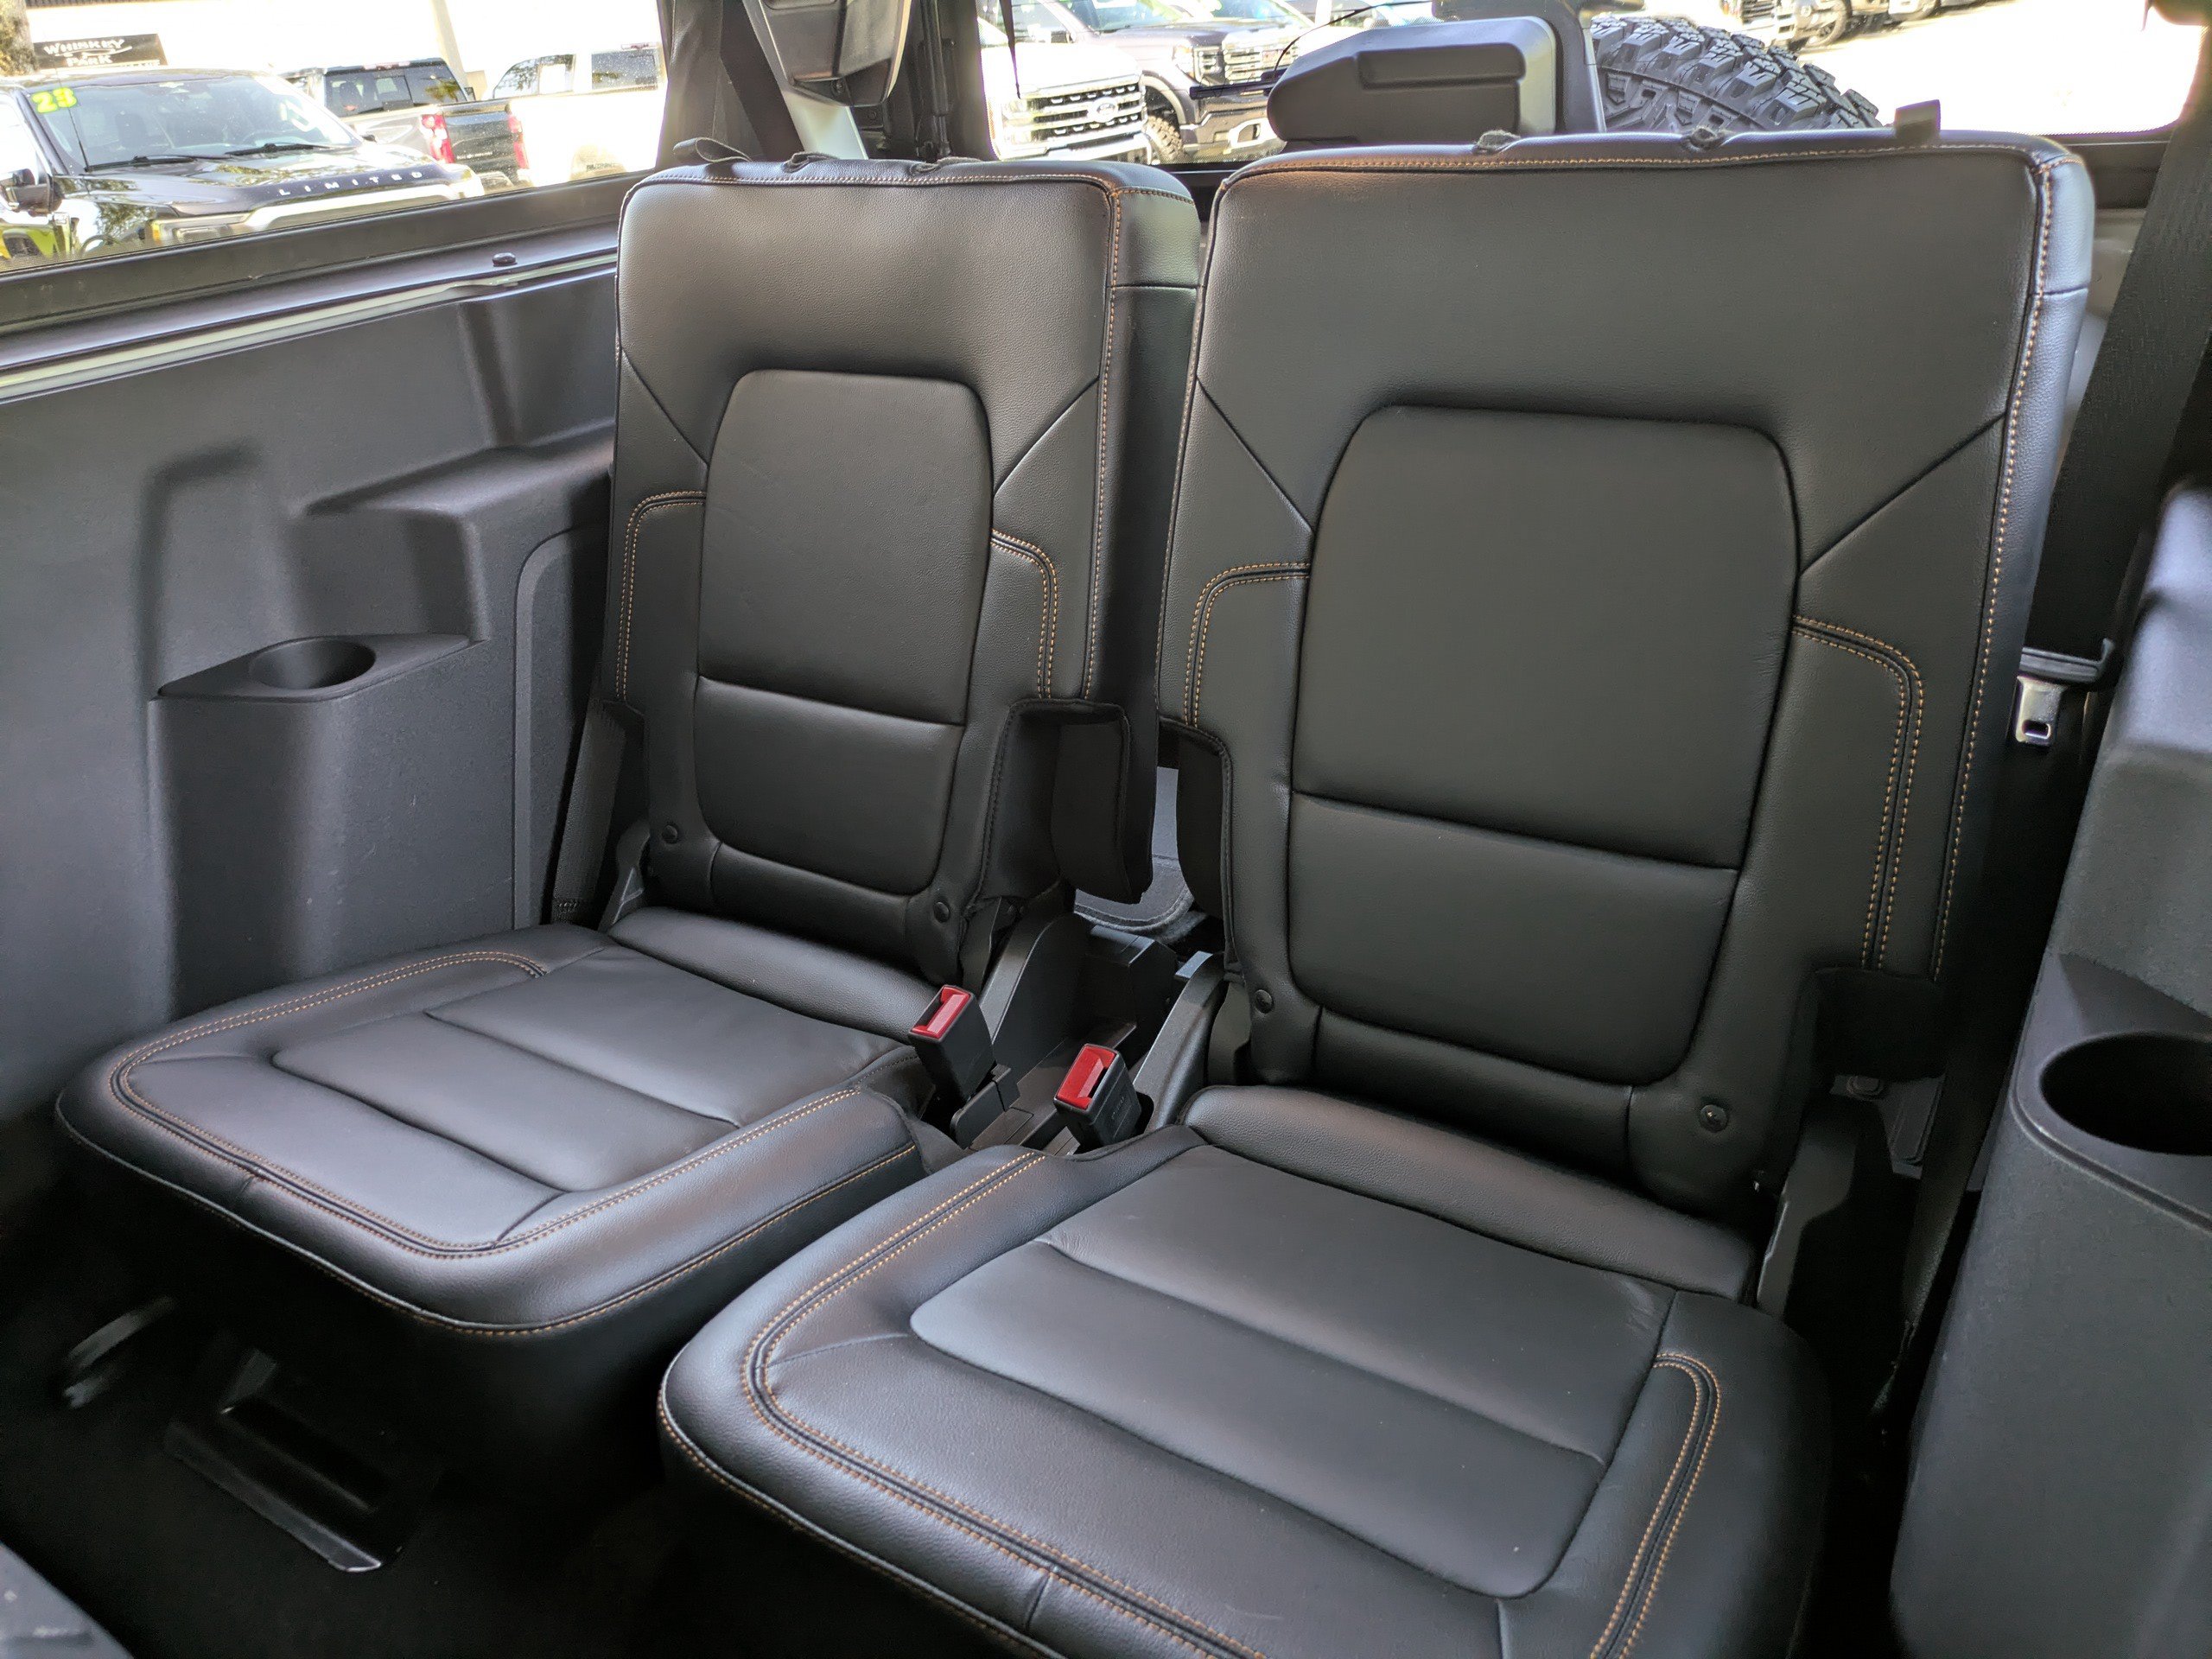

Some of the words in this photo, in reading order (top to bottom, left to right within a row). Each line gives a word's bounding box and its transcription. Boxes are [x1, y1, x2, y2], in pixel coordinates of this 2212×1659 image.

[44, 39, 124, 54] WHISKEY
[67, 54, 112, 67] PARK
[32, 87, 78, 113] 23
[279, 172, 423, 195] LIMITED
